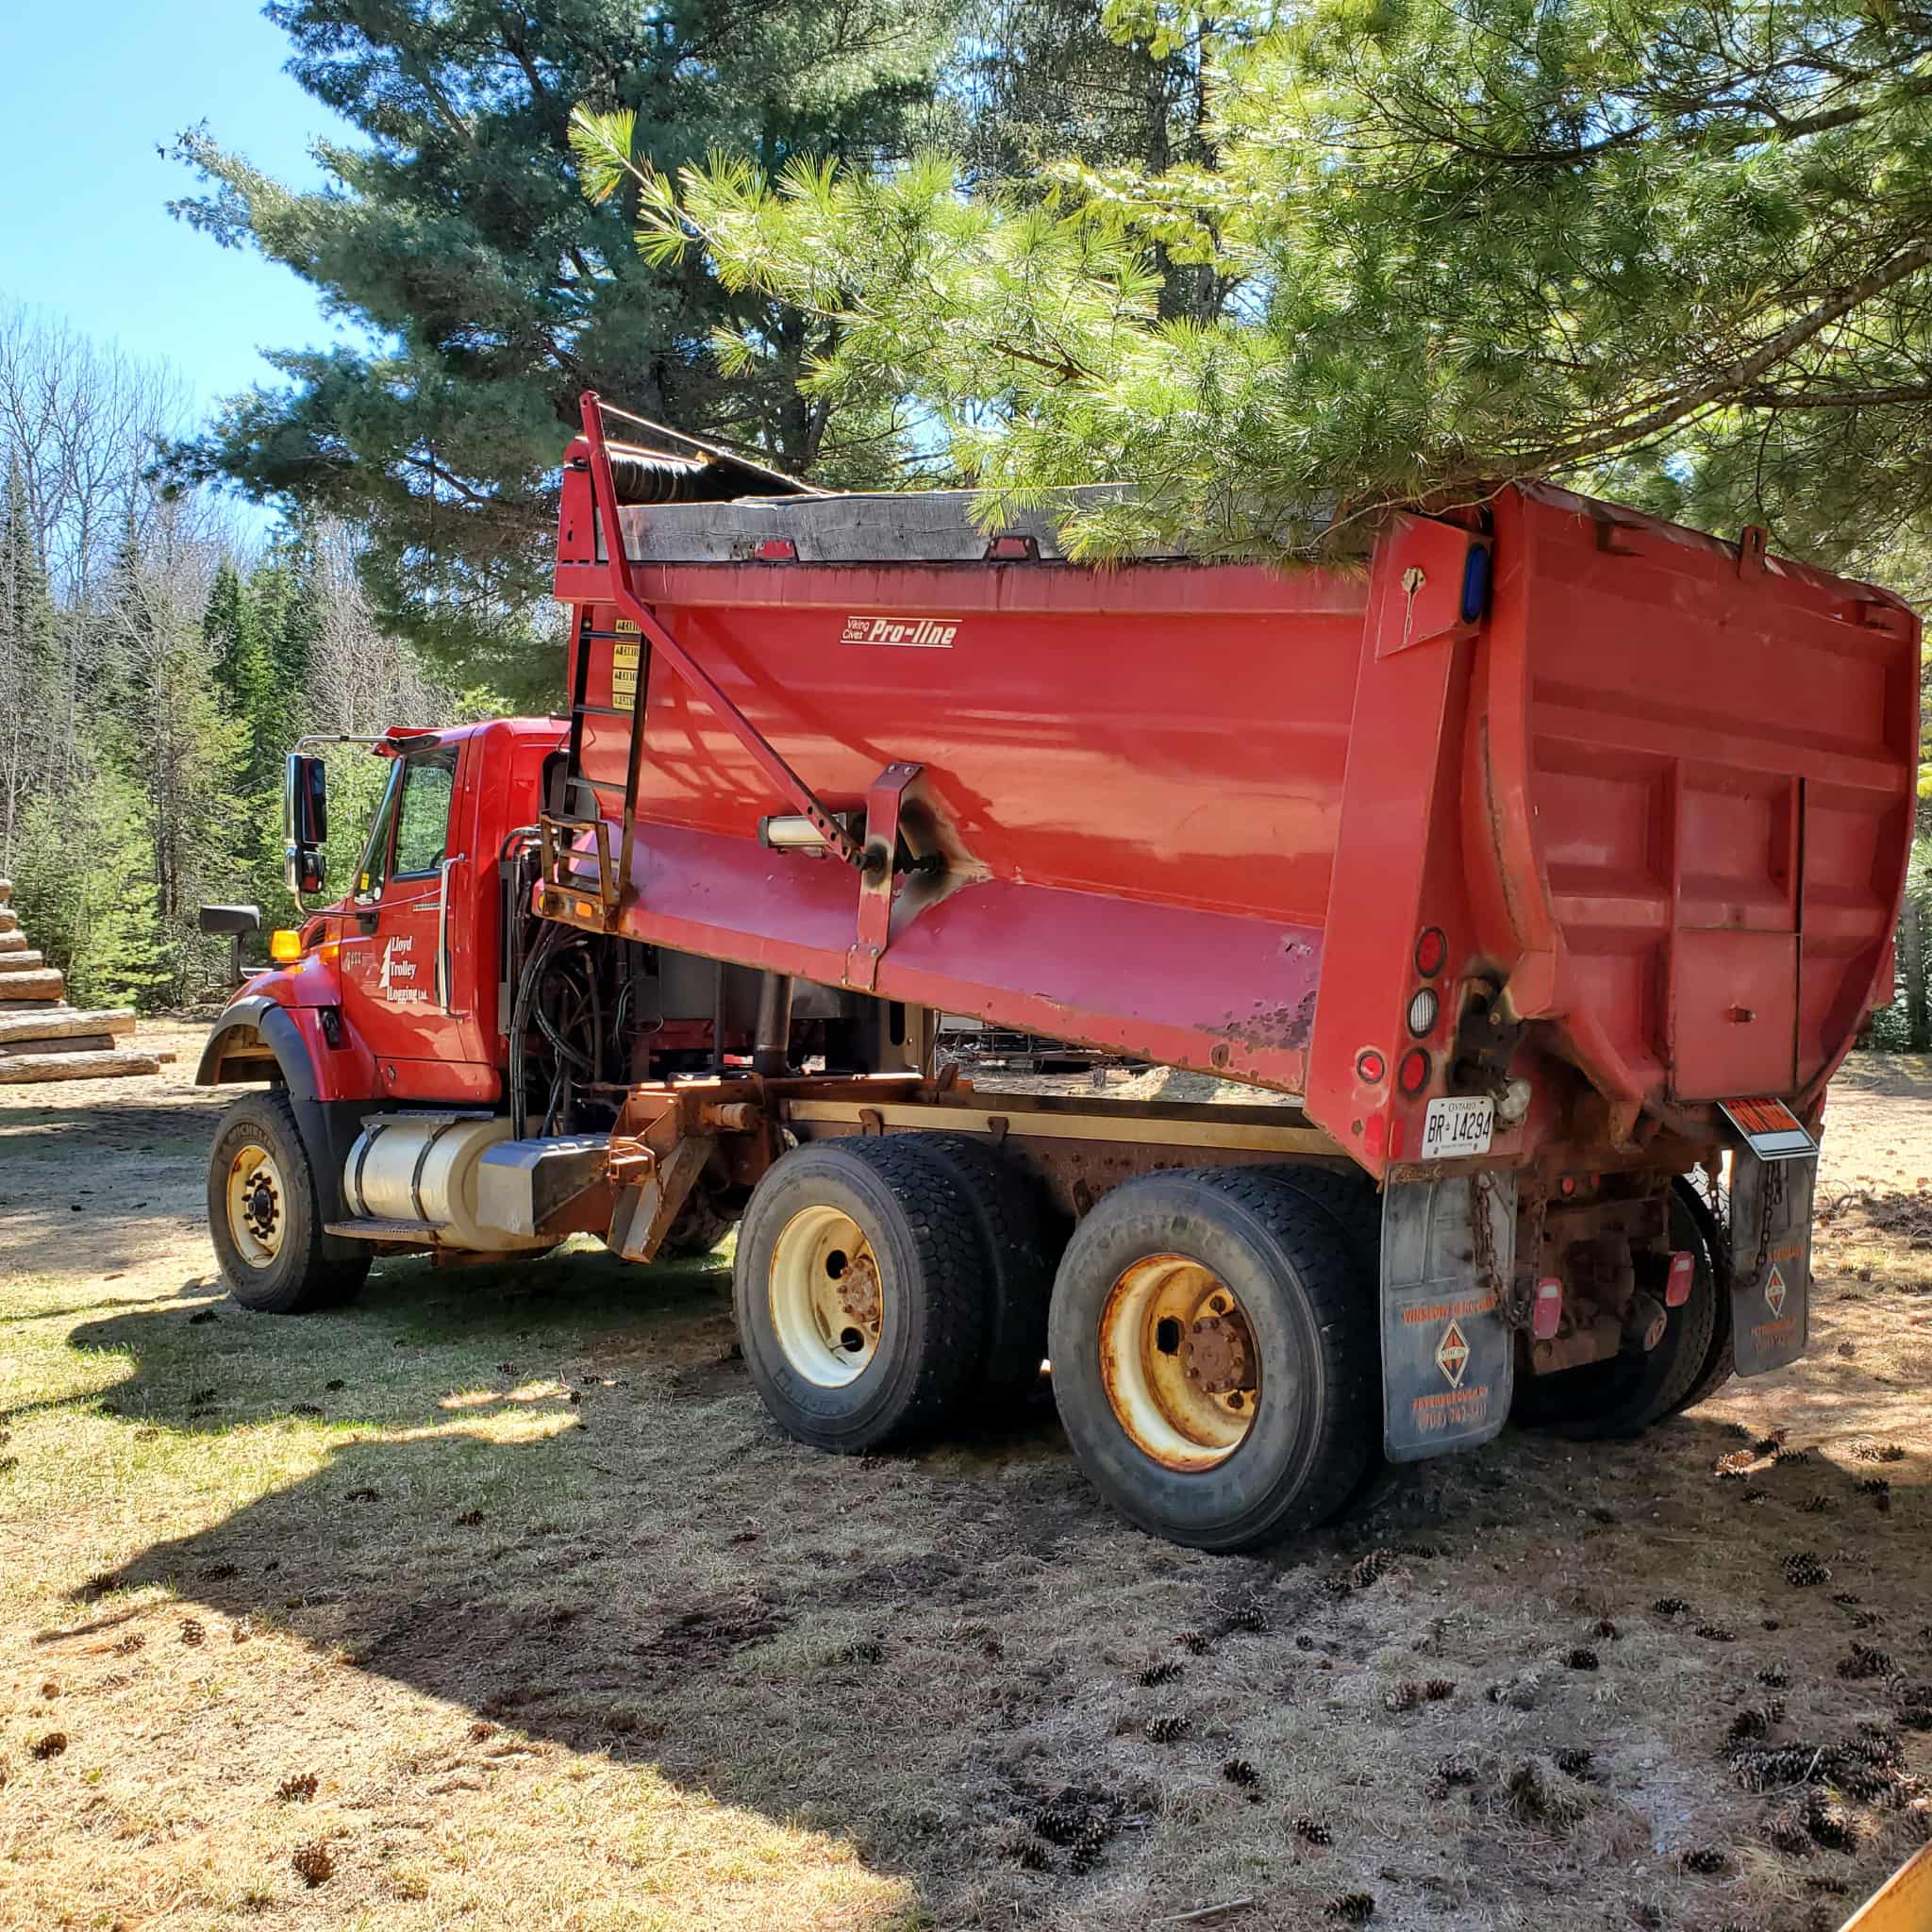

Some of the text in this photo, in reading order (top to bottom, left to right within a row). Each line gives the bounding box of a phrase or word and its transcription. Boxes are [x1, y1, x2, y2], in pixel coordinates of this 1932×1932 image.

[847, 619, 870, 632] Viking
[868, 619, 958, 645] Pro-line
[391, 936, 413, 956] Lloyd
[391, 960, 417, 980] Trolley
[387, 985, 418, 1005] Logging
[1448, 1102, 1476, 1112] ONTARIO
[1451, 1111, 1492, 1141] 14294
